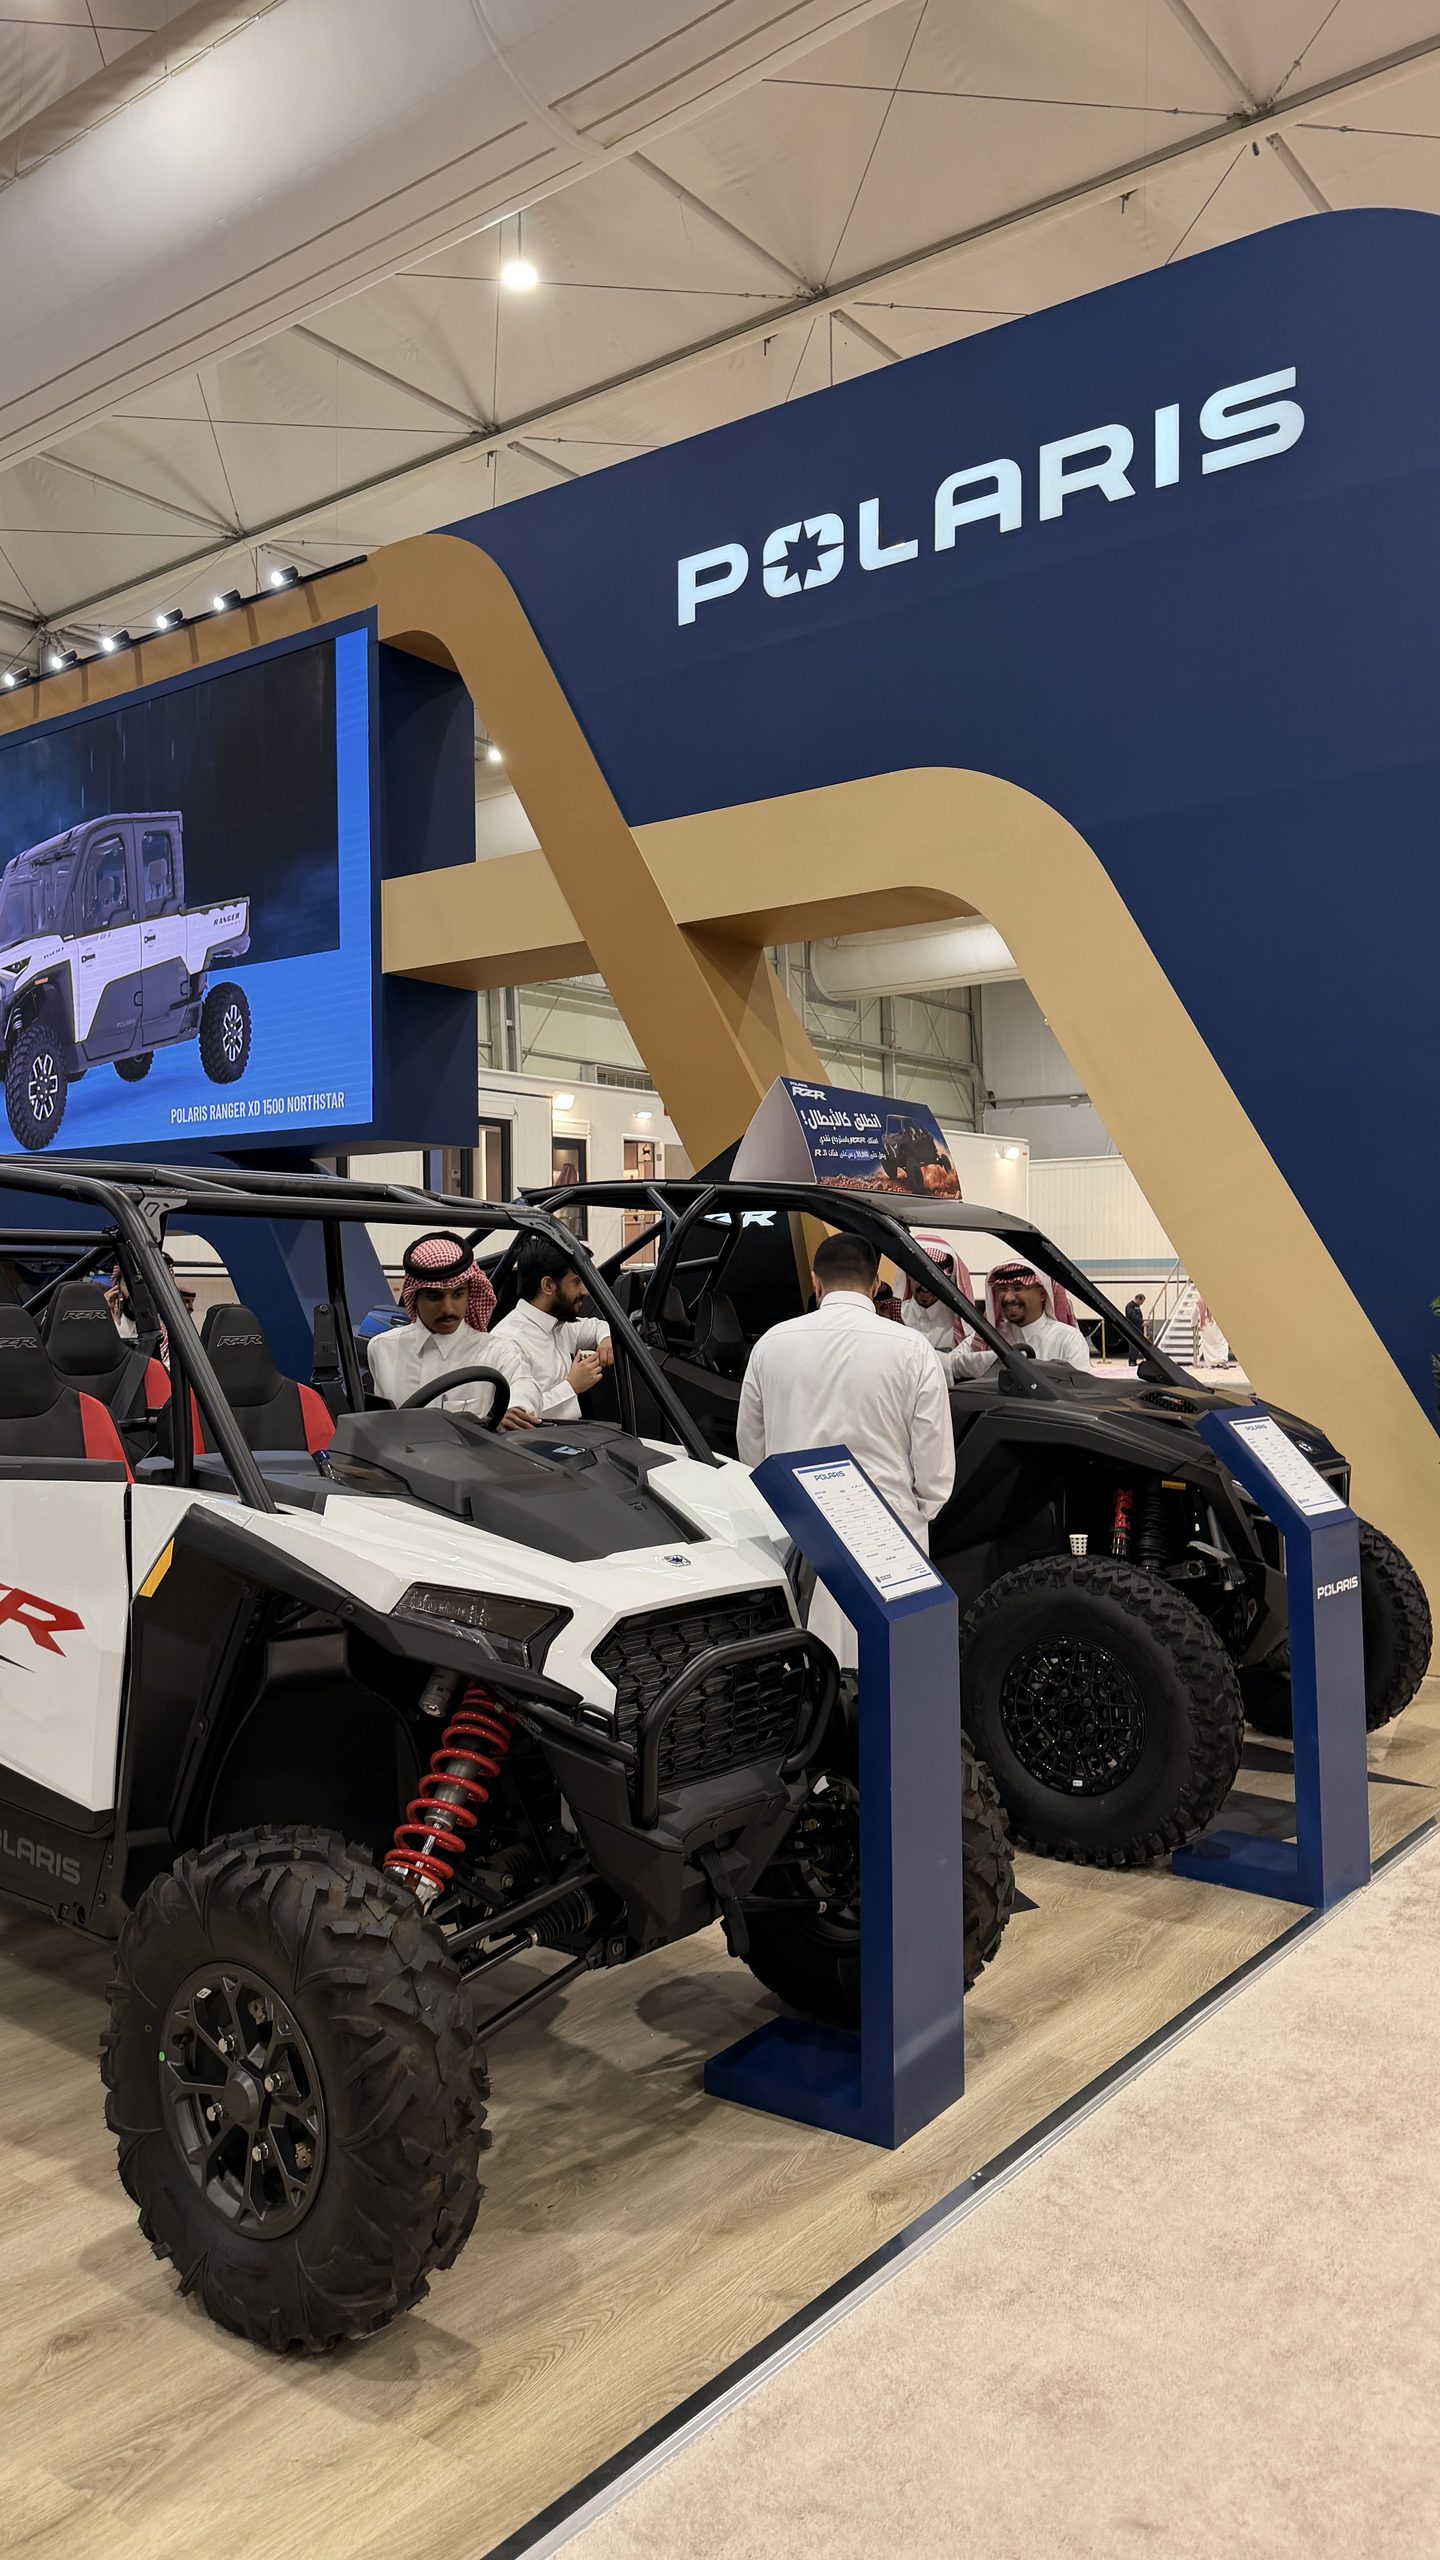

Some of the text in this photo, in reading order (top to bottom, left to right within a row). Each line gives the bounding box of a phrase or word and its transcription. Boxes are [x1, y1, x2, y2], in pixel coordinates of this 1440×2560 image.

[677, 366, 1305, 627] POLARIS
[791, 1086, 827, 1101] RZR
[171, 1091, 345, 1124] POLARIS RANGER XD 1500 NORTHSTAR
[854, 1113, 882, 1131] انطلق
[62, 1309, 107, 1321] RZR
[0, 1336, 38, 1350] ZR
[216, 1333, 263, 1348] RZR
[813, 1470, 846, 1482] POLARIS
[1317, 1575, 1358, 1600] POLARIS
[0, 1827, 81, 1886] LARIS
